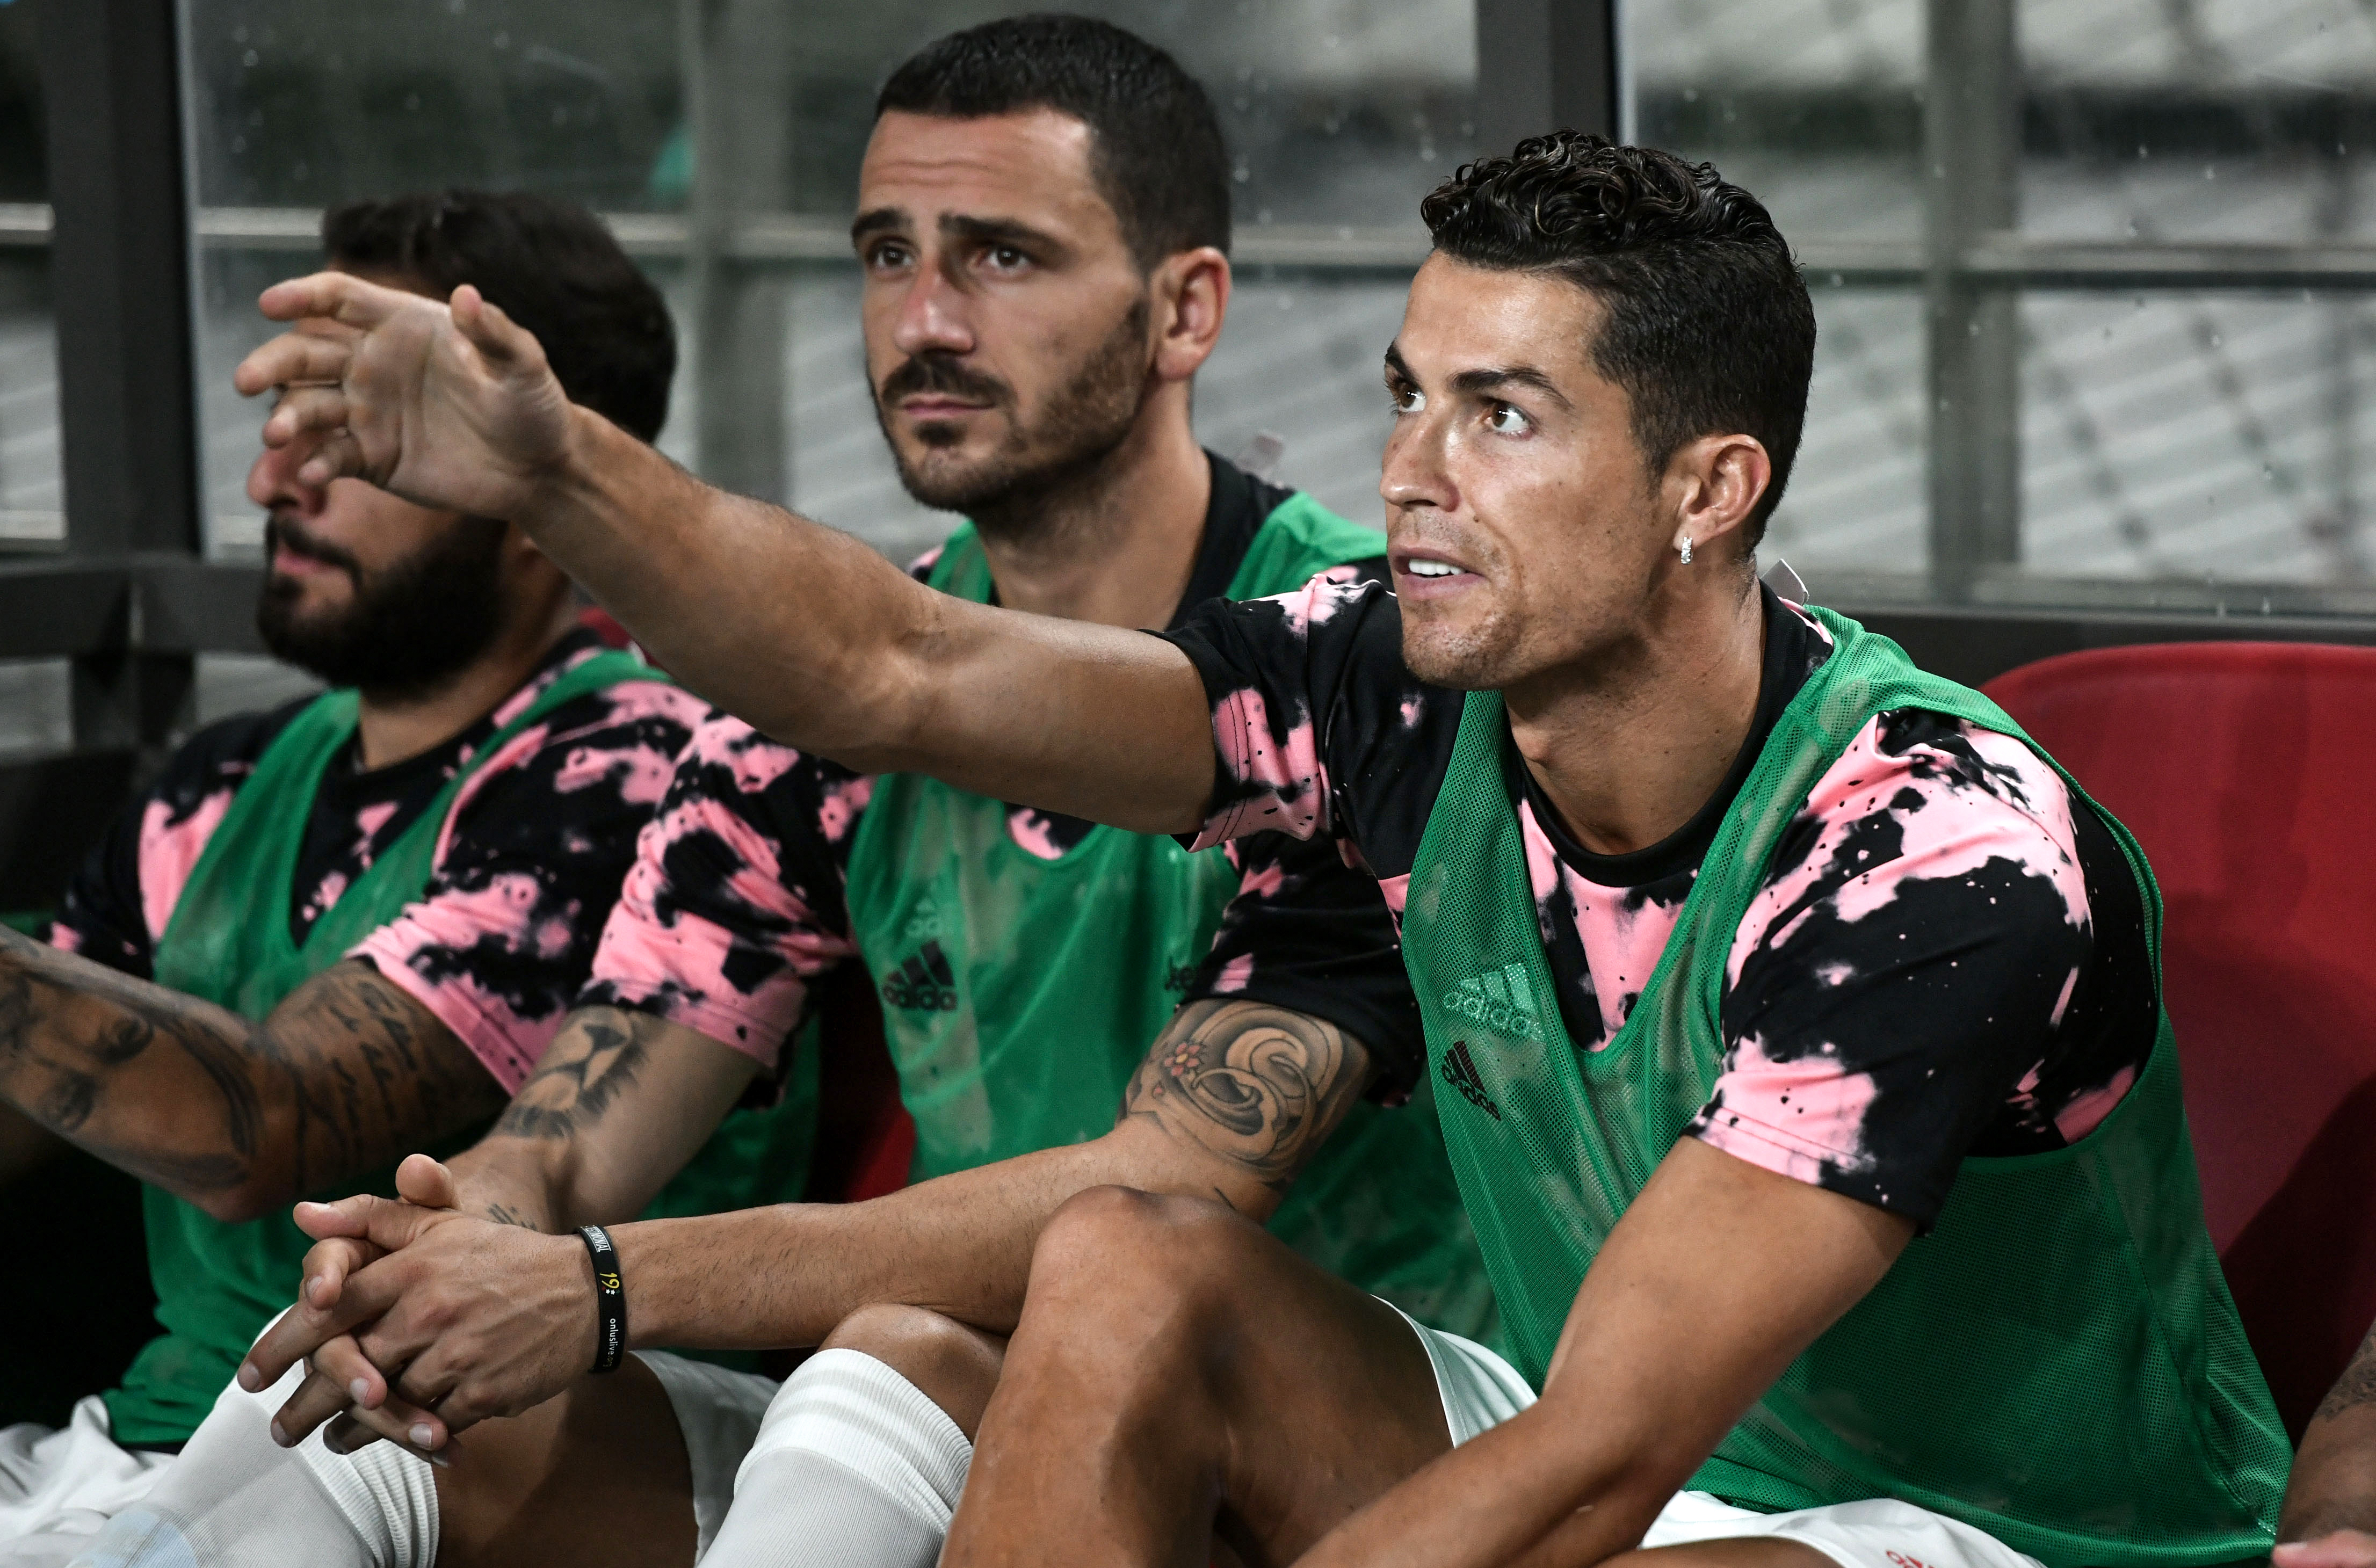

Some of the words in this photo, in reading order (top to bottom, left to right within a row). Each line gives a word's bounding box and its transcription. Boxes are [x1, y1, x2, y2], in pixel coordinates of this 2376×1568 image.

[1443, 992, 1546, 1041] adidas
[599, 1273, 620, 1289] 19
[603, 1318, 619, 1367] onluslive.org
